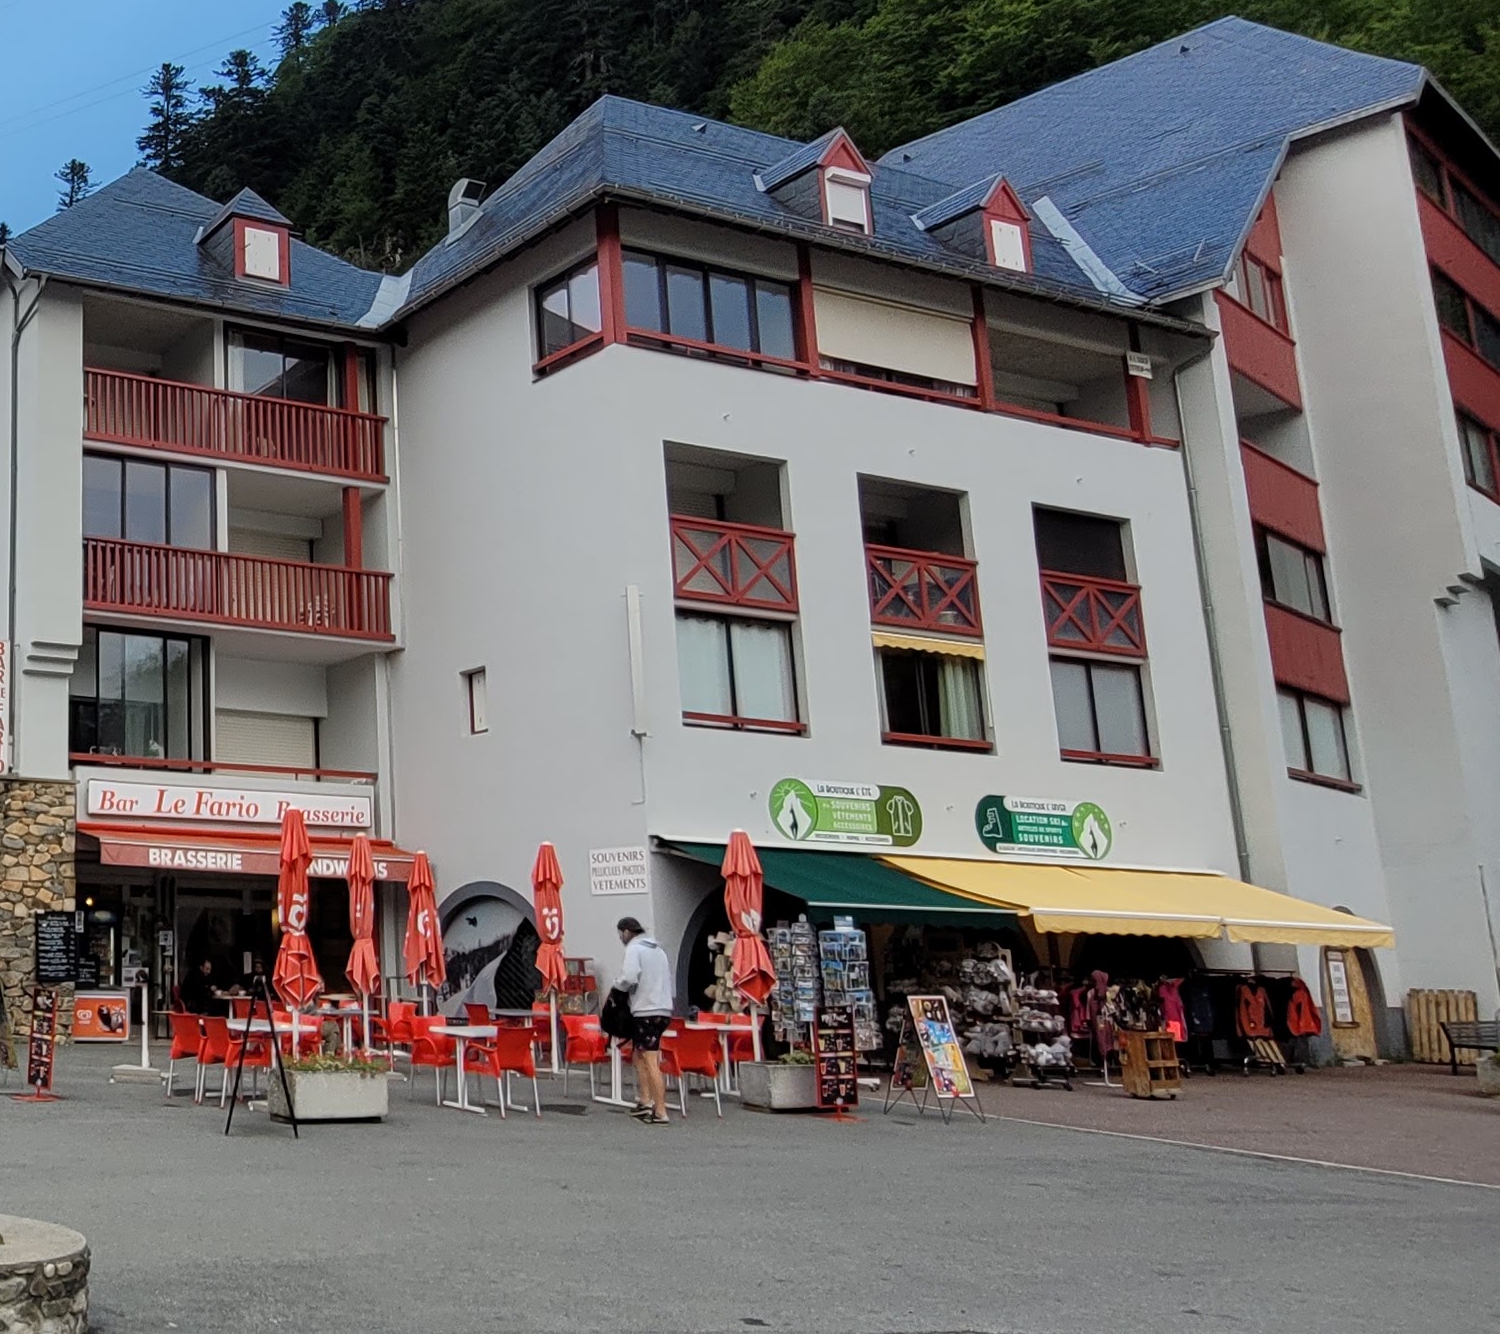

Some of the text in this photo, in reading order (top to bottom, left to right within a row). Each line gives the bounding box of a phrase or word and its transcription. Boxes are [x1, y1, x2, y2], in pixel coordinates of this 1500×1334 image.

[99, 788, 365, 824] Bar Le Fario Basserie
[831, 800, 871, 811] SOUVENIRS
[1016, 815, 1060, 825] LOCATION SKI
[1018, 833, 1064, 844] SOUVENIRS
[148, 848, 243, 869] BRASSERIE
[592, 851, 644, 864] SOUVENIRS
[593, 878, 646, 890] VETEMENTS
